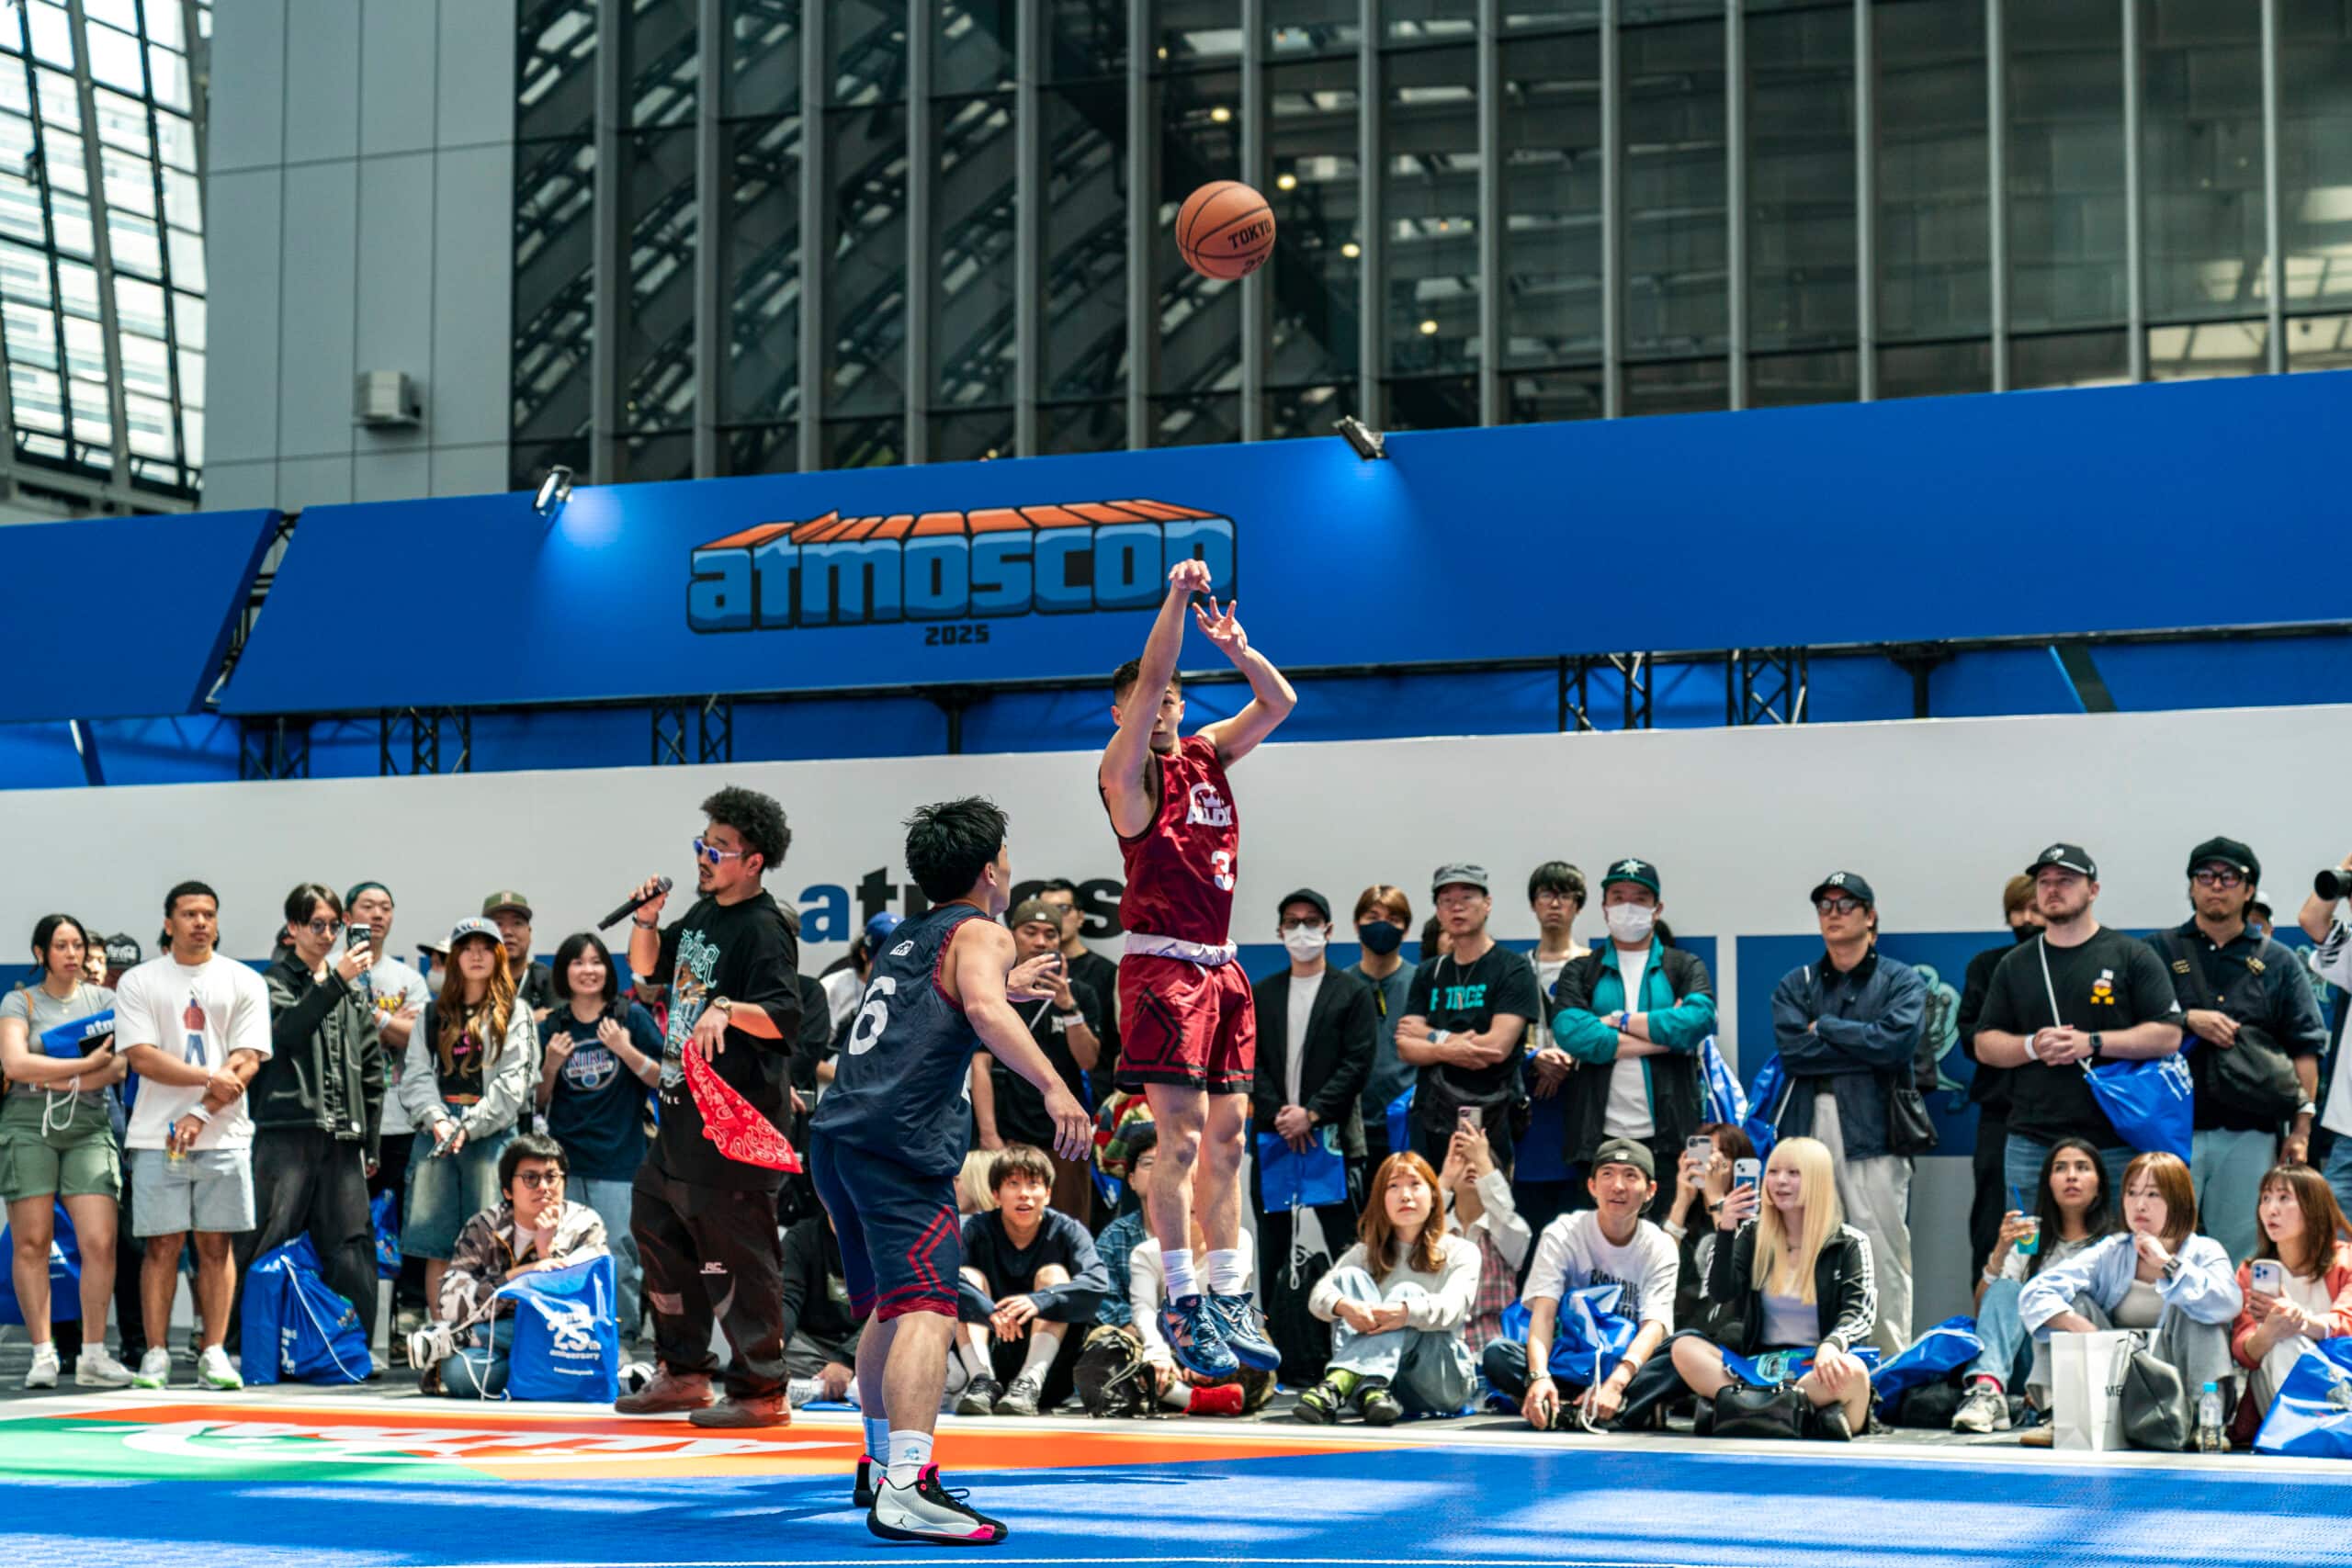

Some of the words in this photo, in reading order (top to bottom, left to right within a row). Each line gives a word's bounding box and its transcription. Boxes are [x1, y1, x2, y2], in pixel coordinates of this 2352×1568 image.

[1227, 219, 1272, 250] TOKYO
[925, 625, 989, 646] 2025
[1211, 851, 1234, 891] 3
[798, 866, 1125, 943] ats
[848, 976, 897, 1055] 6
[569, 1048, 608, 1068] NIKE
